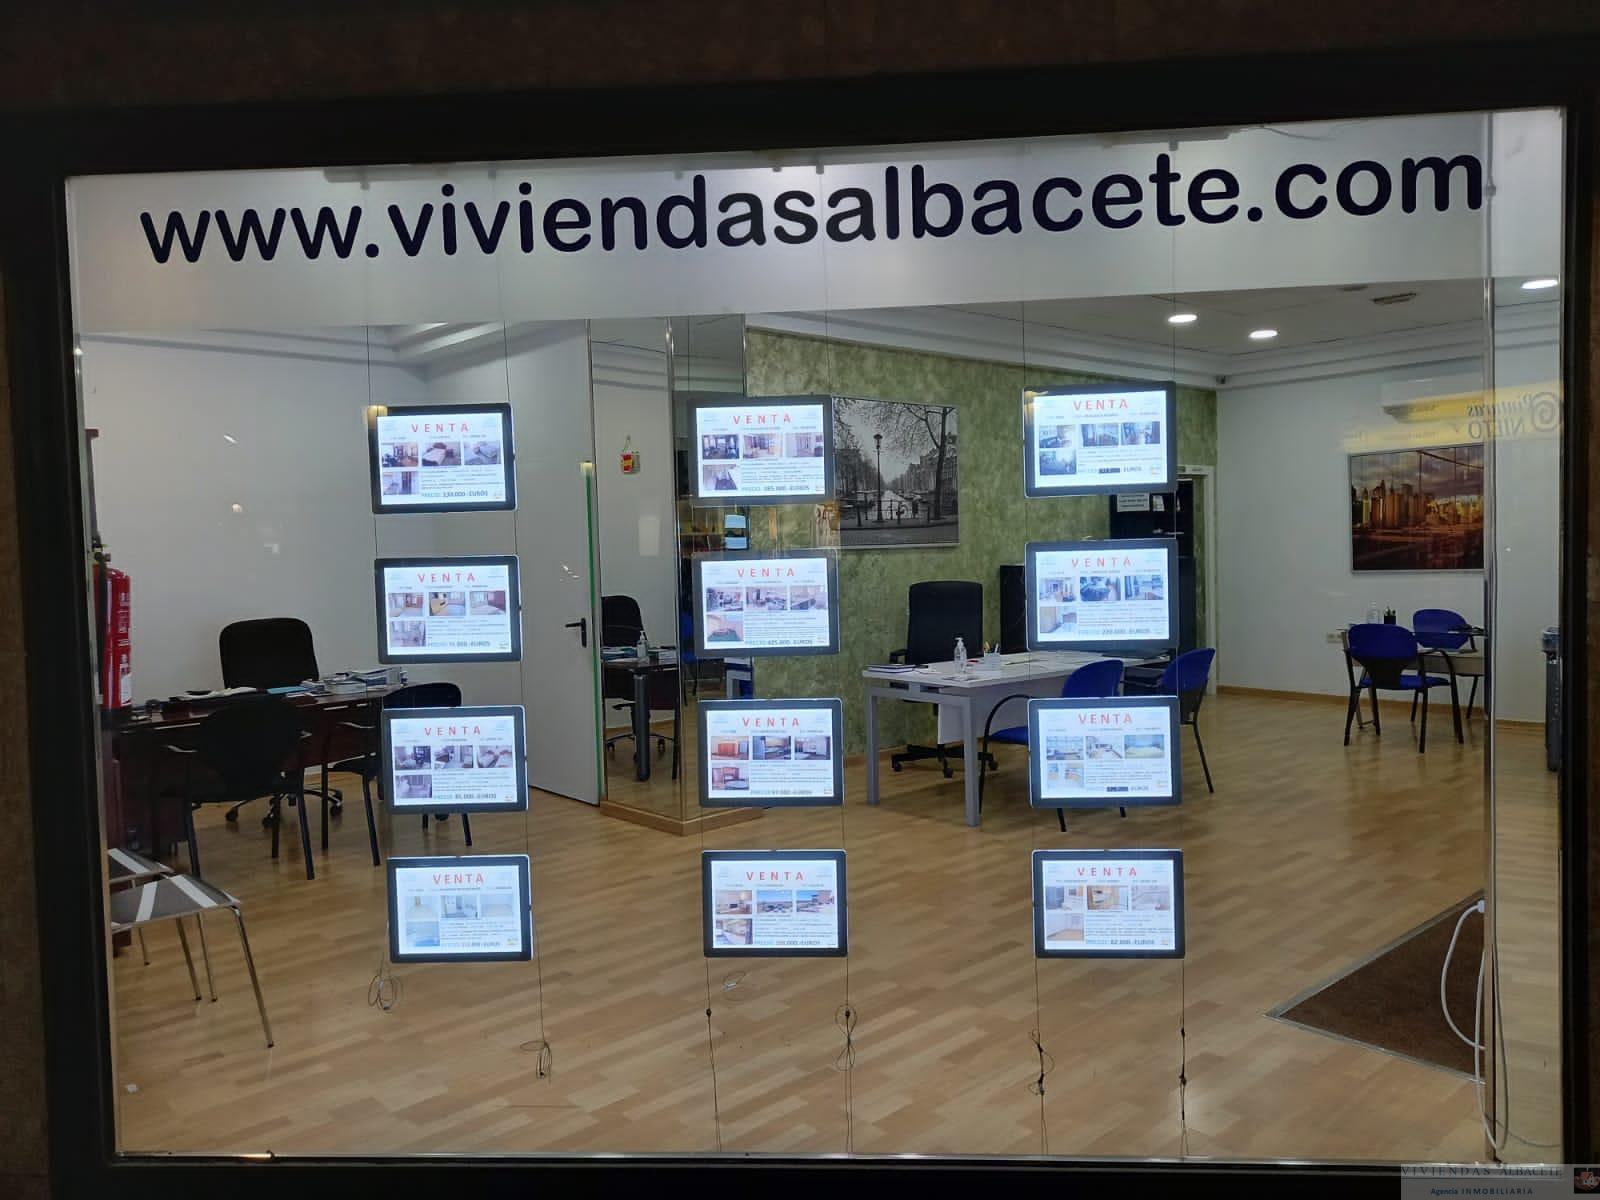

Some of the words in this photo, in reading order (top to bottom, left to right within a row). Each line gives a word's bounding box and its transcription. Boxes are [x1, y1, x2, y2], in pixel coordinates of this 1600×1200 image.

[139, 153, 1482, 264] www.viviendasalbacete.com
[1073, 397, 1129, 411] VENTA
[732, 411, 793, 425] VENTA
[410, 422, 470, 434] VENTA
[1072, 555, 1132, 568] VENTA
[417, 572, 477, 584] VENTA
[737, 567, 797, 578] VENTA
[742, 717, 801, 729] VENTA
[1078, 712, 1134, 725] VENTA
[423, 725, 482, 737] VENTA
[746, 870, 806, 882] VENTA
[1077, 865, 1138, 877] VENTA
[433, 872, 486, 885] VENTA
